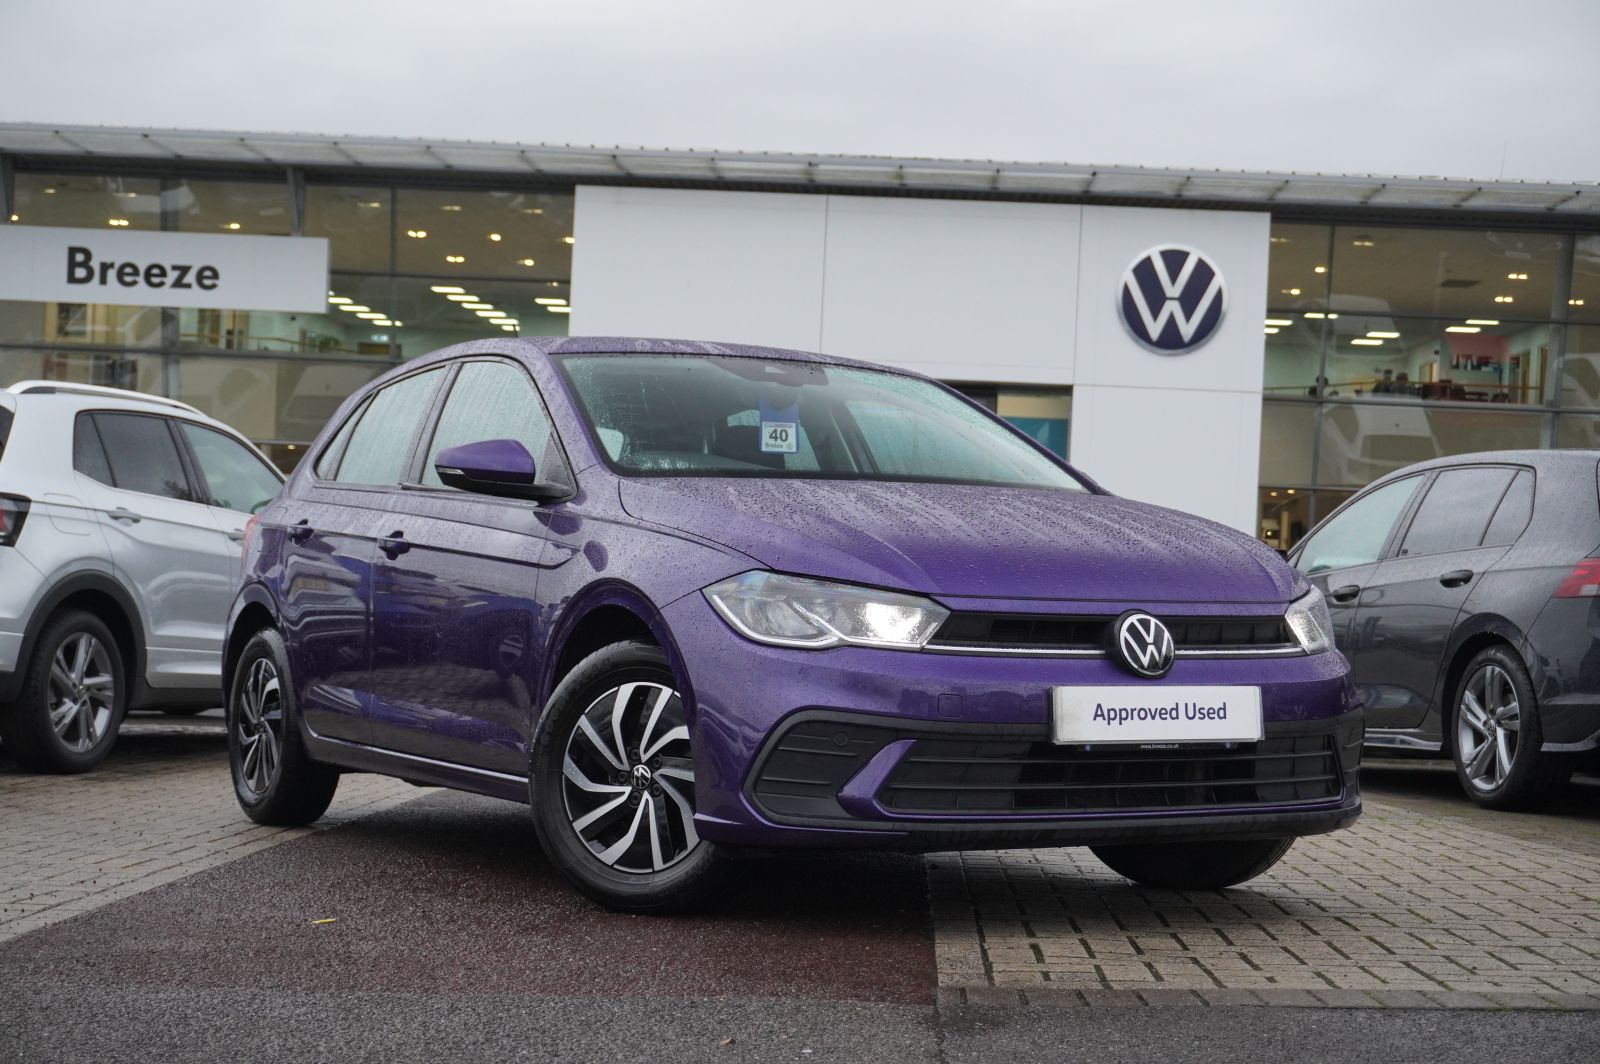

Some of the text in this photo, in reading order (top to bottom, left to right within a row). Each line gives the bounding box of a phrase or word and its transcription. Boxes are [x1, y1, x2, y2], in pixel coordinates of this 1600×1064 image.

[66, 246, 220, 291] Breeze
[769, 428, 789, 442] 40
[1092, 702, 1228, 726] Approved Used
